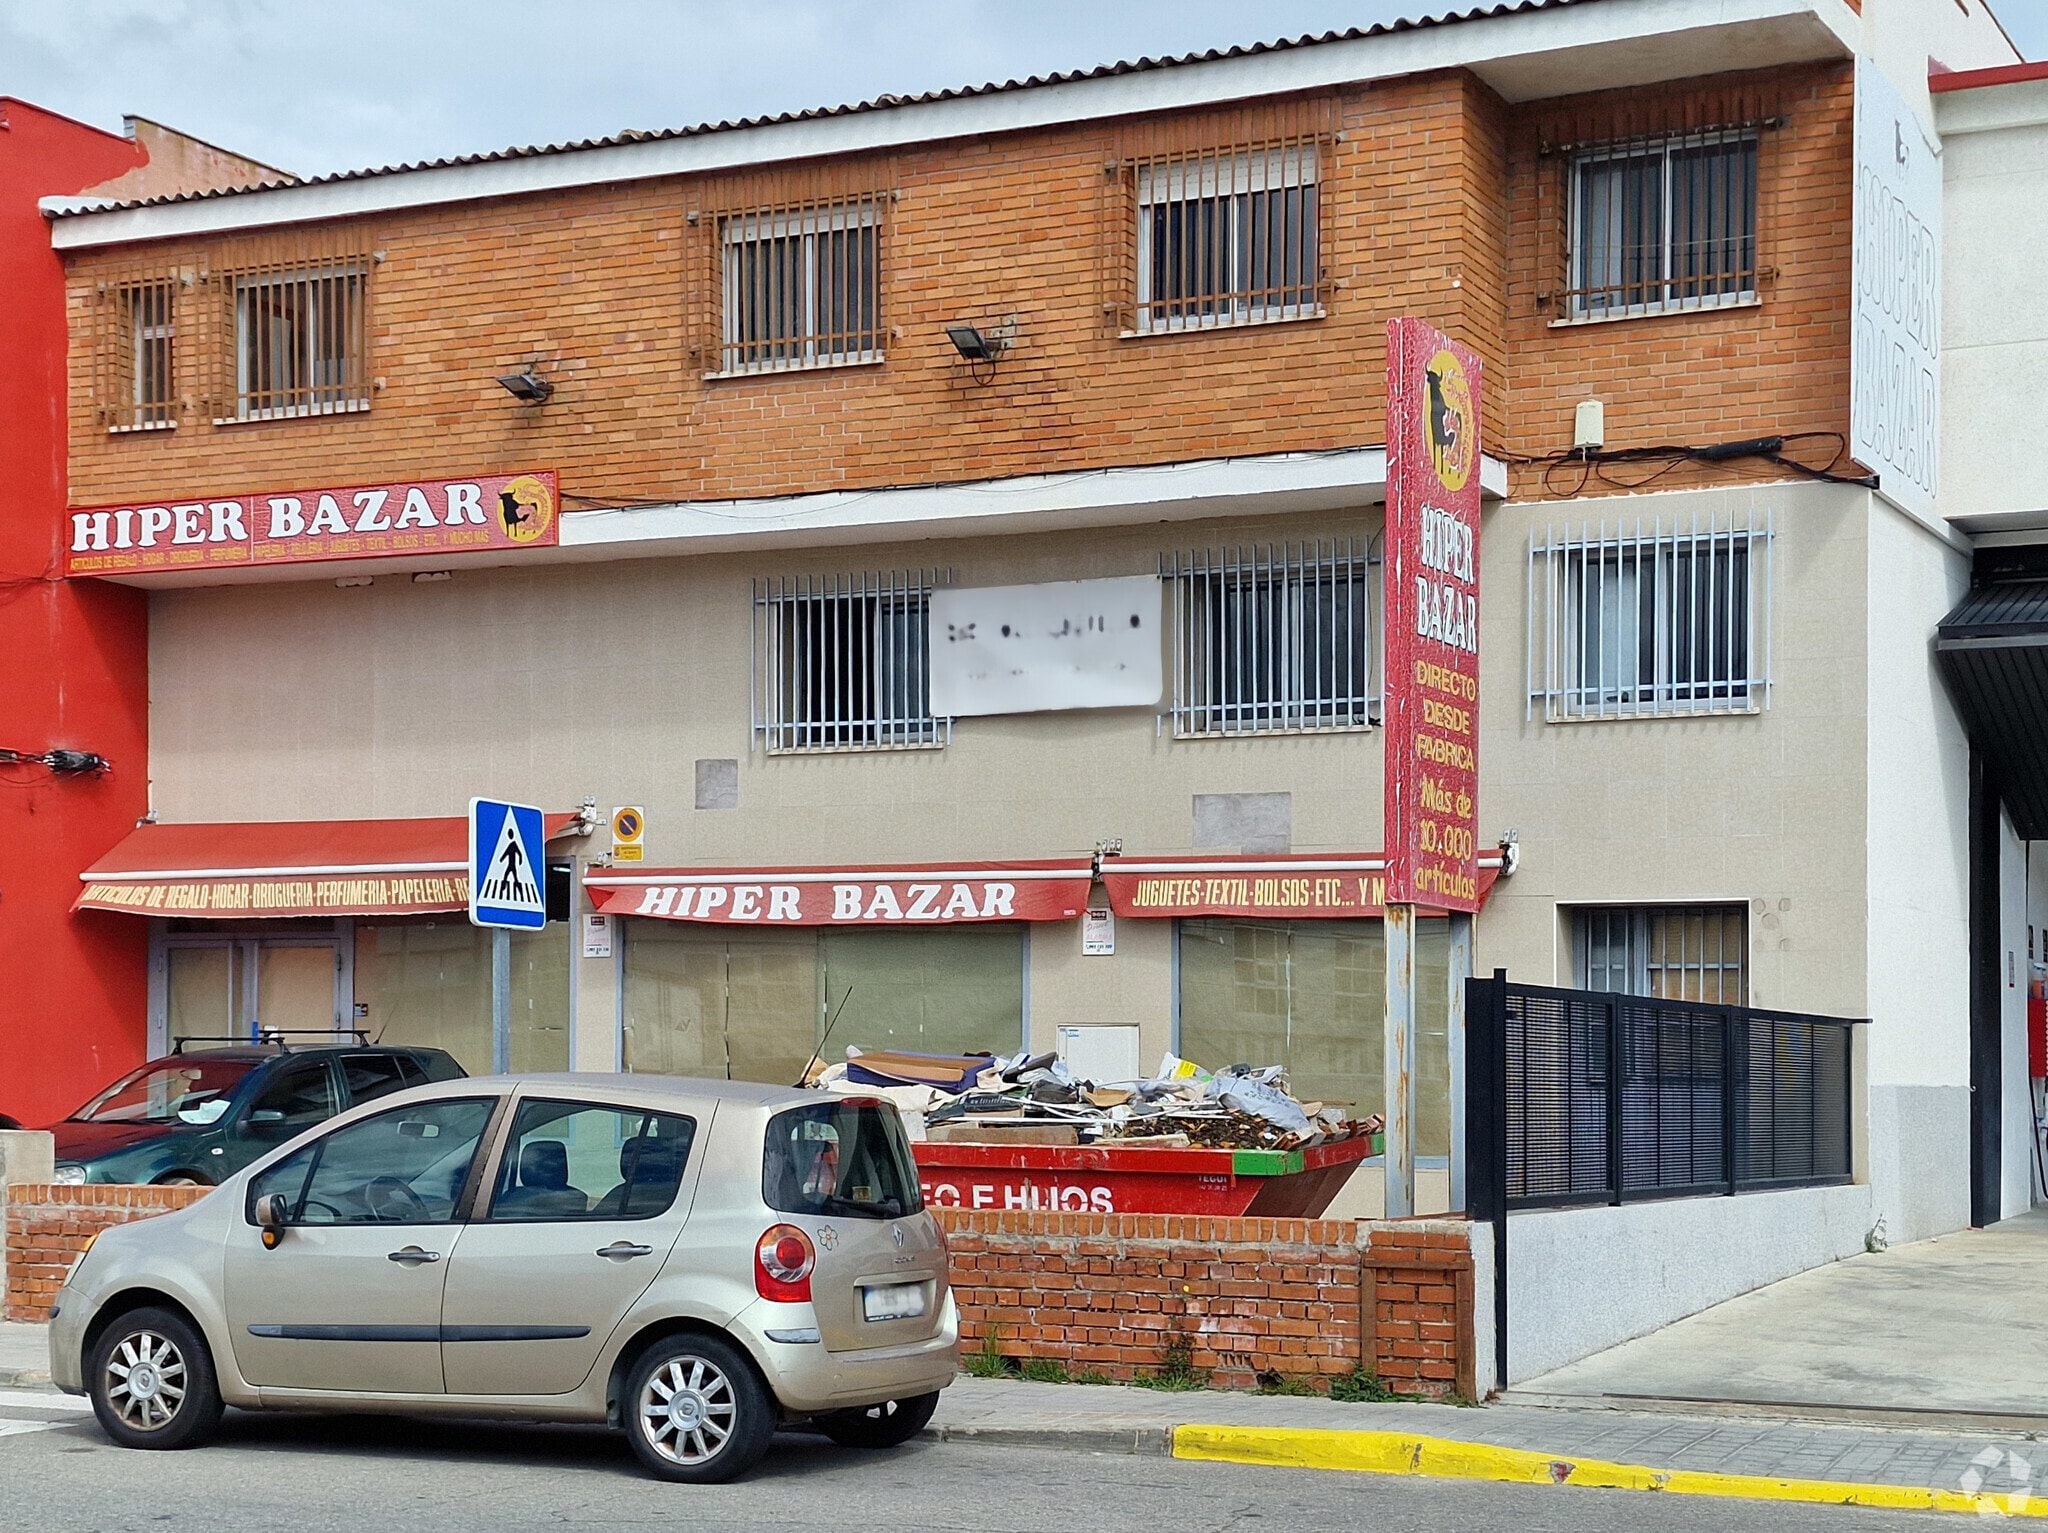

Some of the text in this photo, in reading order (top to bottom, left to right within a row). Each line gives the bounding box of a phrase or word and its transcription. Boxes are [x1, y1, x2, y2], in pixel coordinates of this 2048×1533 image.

[70, 483, 488, 552] HIPER BAZAR
[1421, 505, 1475, 585] HIPER
[1415, 573, 1477, 655] BAZAR
[1416, 659, 1476, 701] DIRECTO
[1424, 698, 1470, 735] DESDE
[1416, 734, 1475, 772] FABRICA
[1421, 778, 1472, 819] Más de
[1419, 819, 1472, 861] 10.000
[80, 884, 150, 906] ARTICULOS
[146, 885, 166, 908] DE
[1358, 878, 1369, 905] Y
[1372, 878, 1385, 905] M
[1415, 860, 1476, 901] artículos
[635, 883, 1015, 920] HIPER BAZAR
